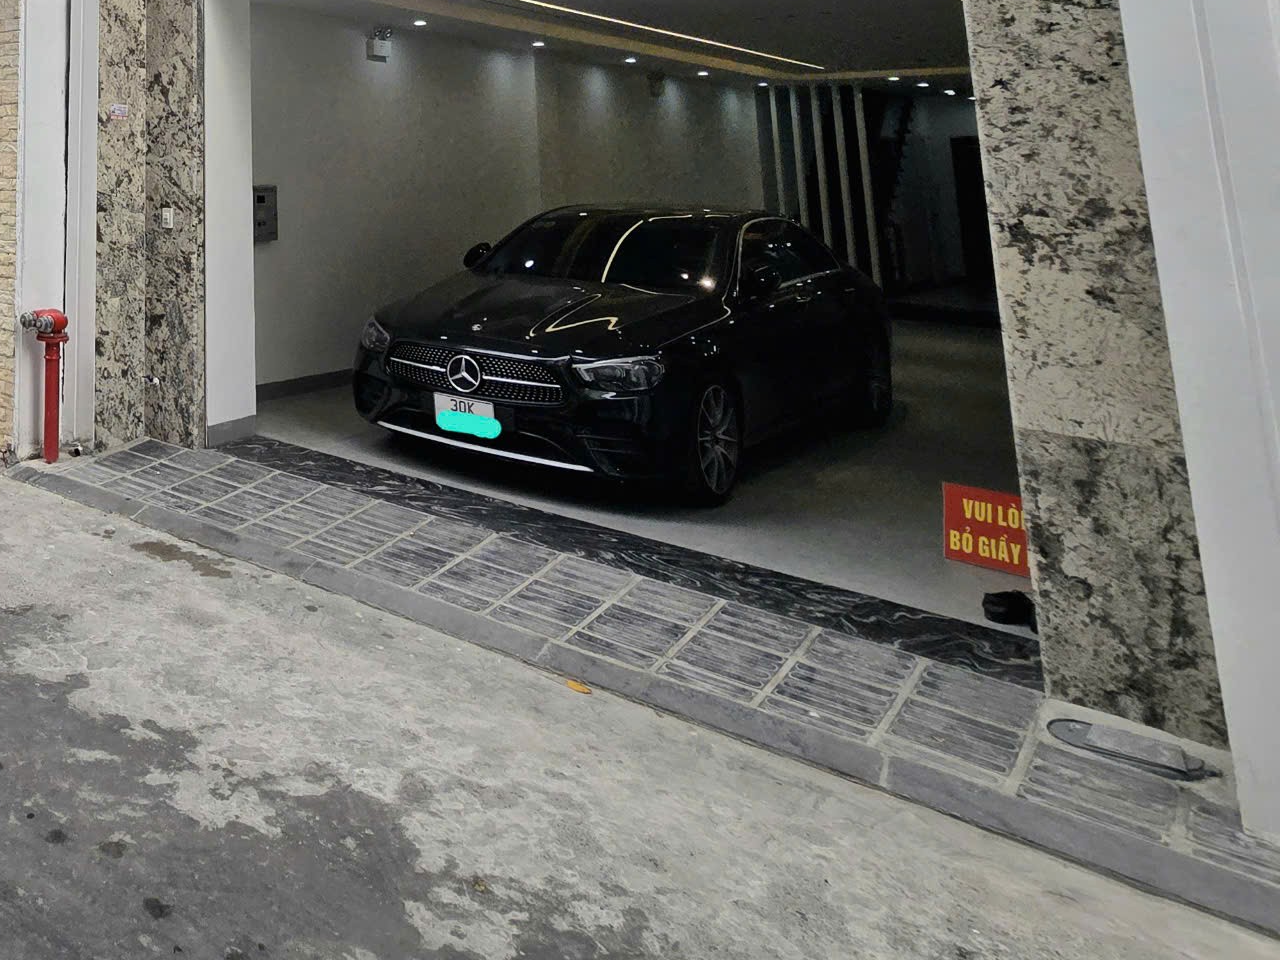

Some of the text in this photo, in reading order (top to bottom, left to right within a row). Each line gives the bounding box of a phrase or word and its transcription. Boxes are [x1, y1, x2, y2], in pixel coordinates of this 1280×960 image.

[450, 398, 475, 414] 30K
[962, 498, 992, 524] VUI
[949, 526, 973, 554] BỎ
